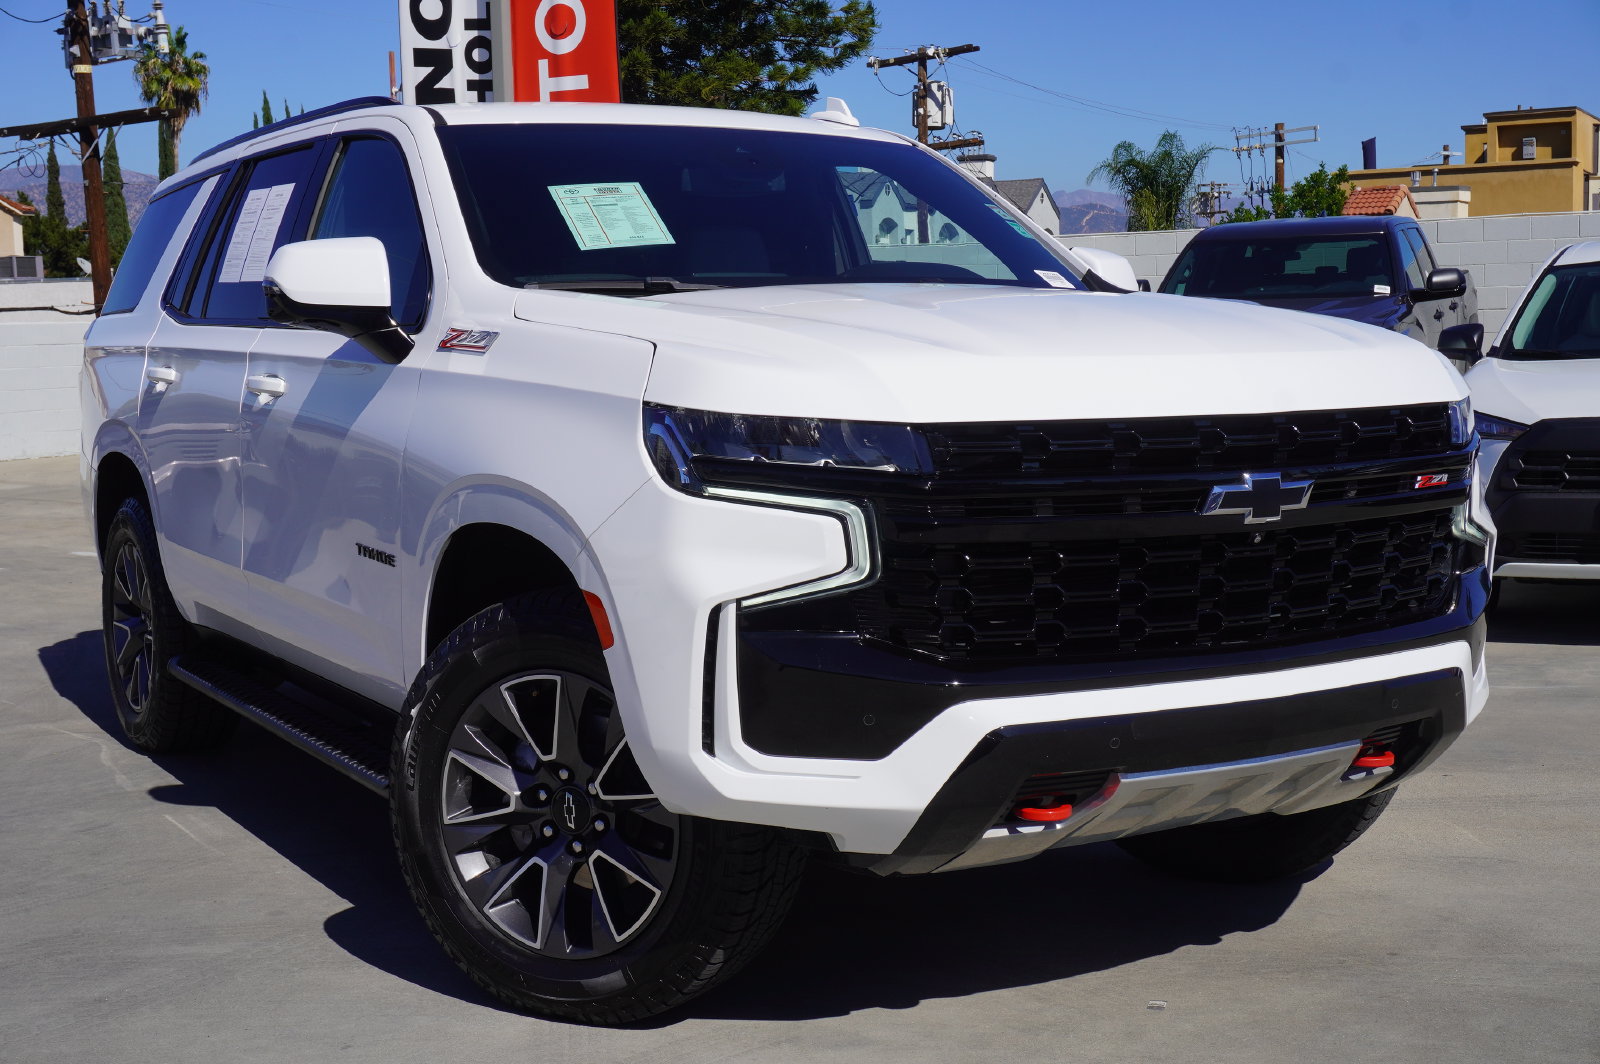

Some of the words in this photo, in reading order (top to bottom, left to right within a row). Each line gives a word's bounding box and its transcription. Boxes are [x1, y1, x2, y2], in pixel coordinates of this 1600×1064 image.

[534, 0, 589, 103] TO
[1415, 474, 1448, 488] Z71
[355, 542, 396, 568] TAHOE
